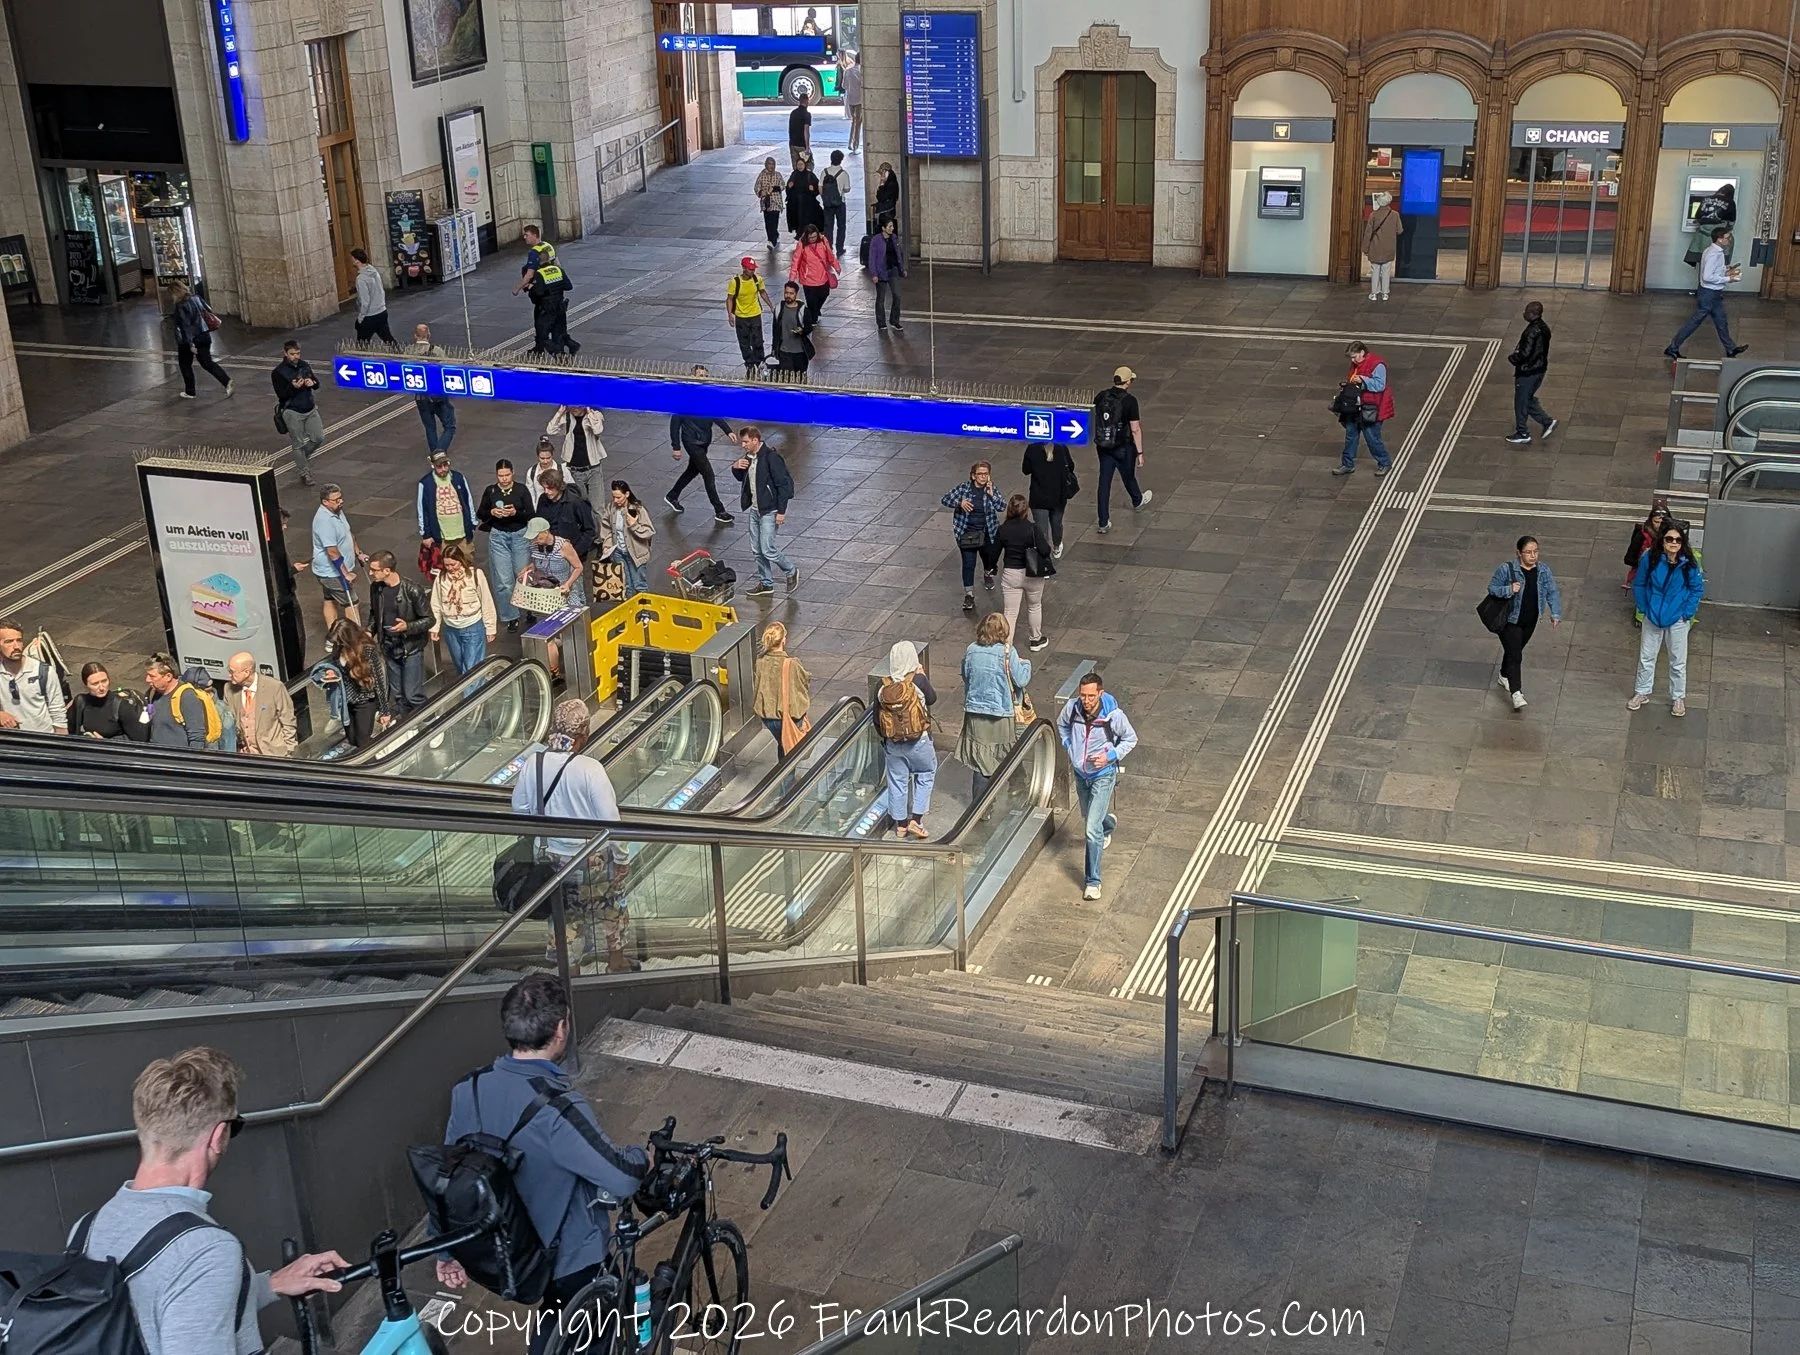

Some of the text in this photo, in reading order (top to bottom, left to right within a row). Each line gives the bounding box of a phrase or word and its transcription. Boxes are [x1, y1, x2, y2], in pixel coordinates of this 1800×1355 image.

[1546, 129, 1610, 144] CHANGE
[366, 371, 385, 385] 30
[405, 373, 424, 388] 35
[166, 525, 250, 541] um Aktien voll
[168, 540, 252, 554] auszukosten!
